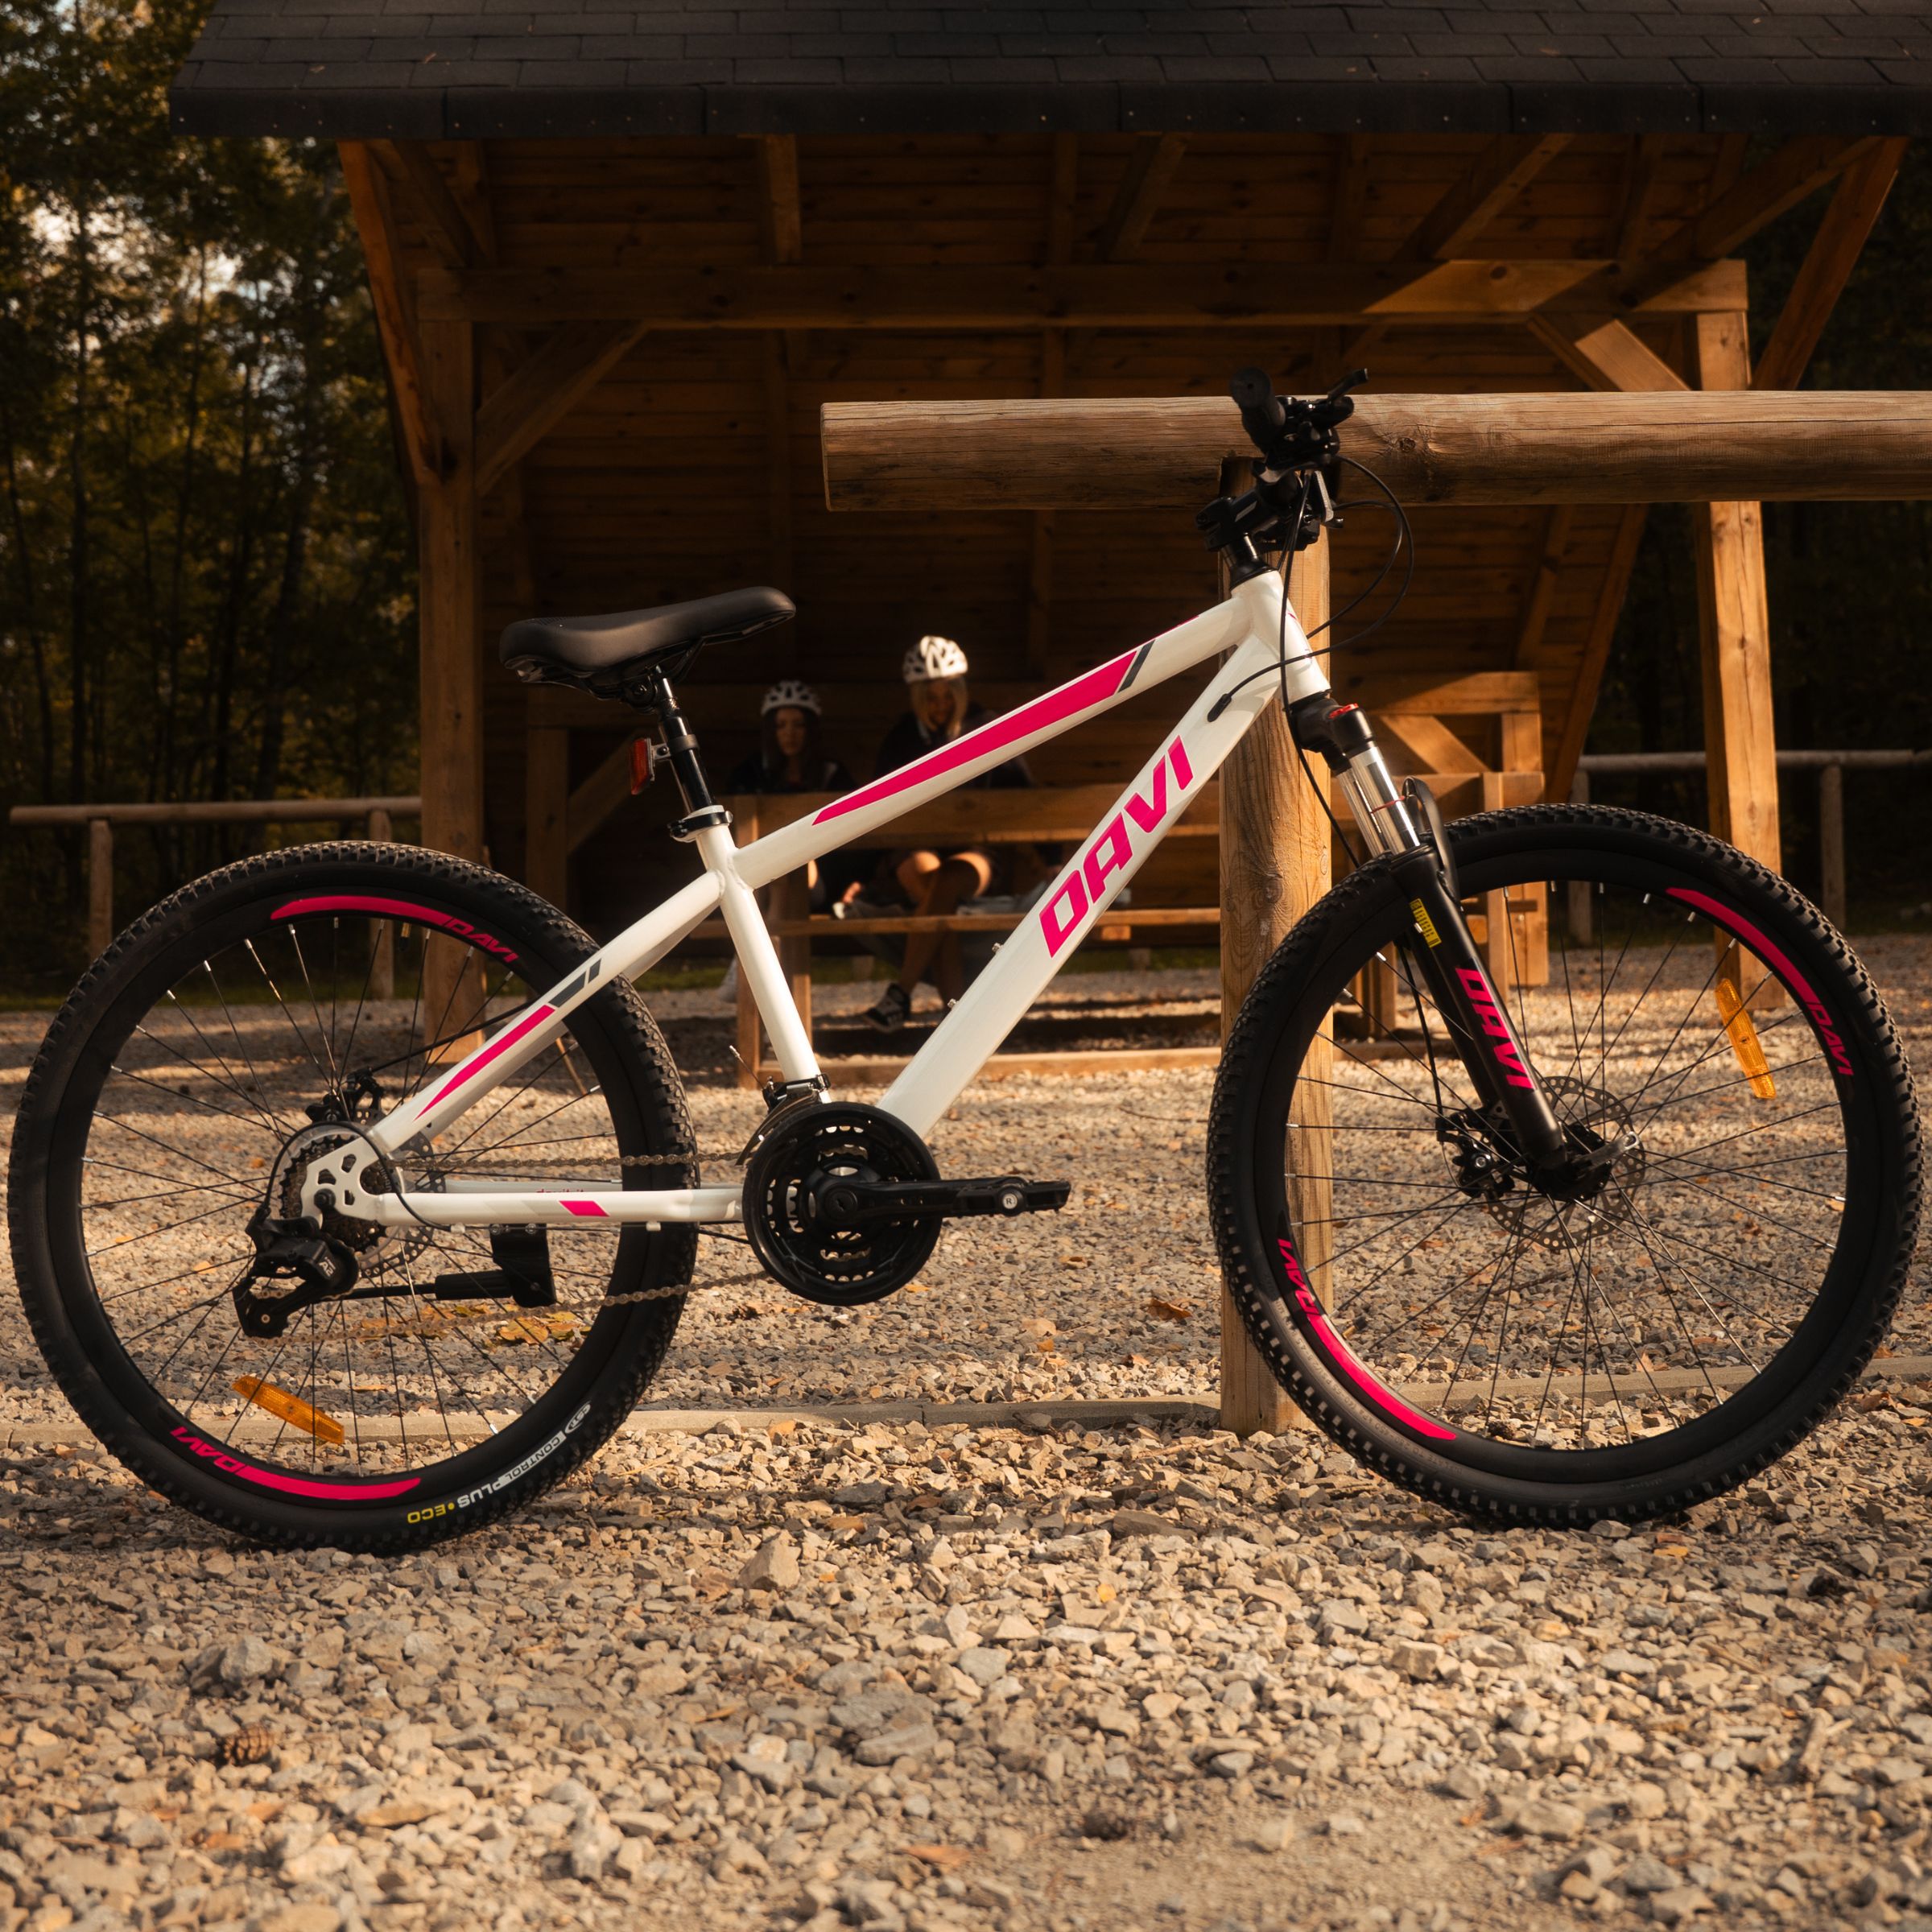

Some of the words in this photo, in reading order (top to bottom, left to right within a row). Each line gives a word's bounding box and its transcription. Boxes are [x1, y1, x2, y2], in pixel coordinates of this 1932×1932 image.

[1039, 734, 1193, 958] DAVI
[444, 919, 519, 963] DAVI
[1455, 968, 1534, 1089] DAVI
[1806, 1003, 1854, 1075] DAVI
[1278, 1239, 1319, 1314] DAVI
[170, 1426, 246, 1473] DAVI
[506, 1437, 561, 1480] CONTROL
[407, 1504, 446, 1524] ECO
[457, 1476, 507, 1509] PLUS
